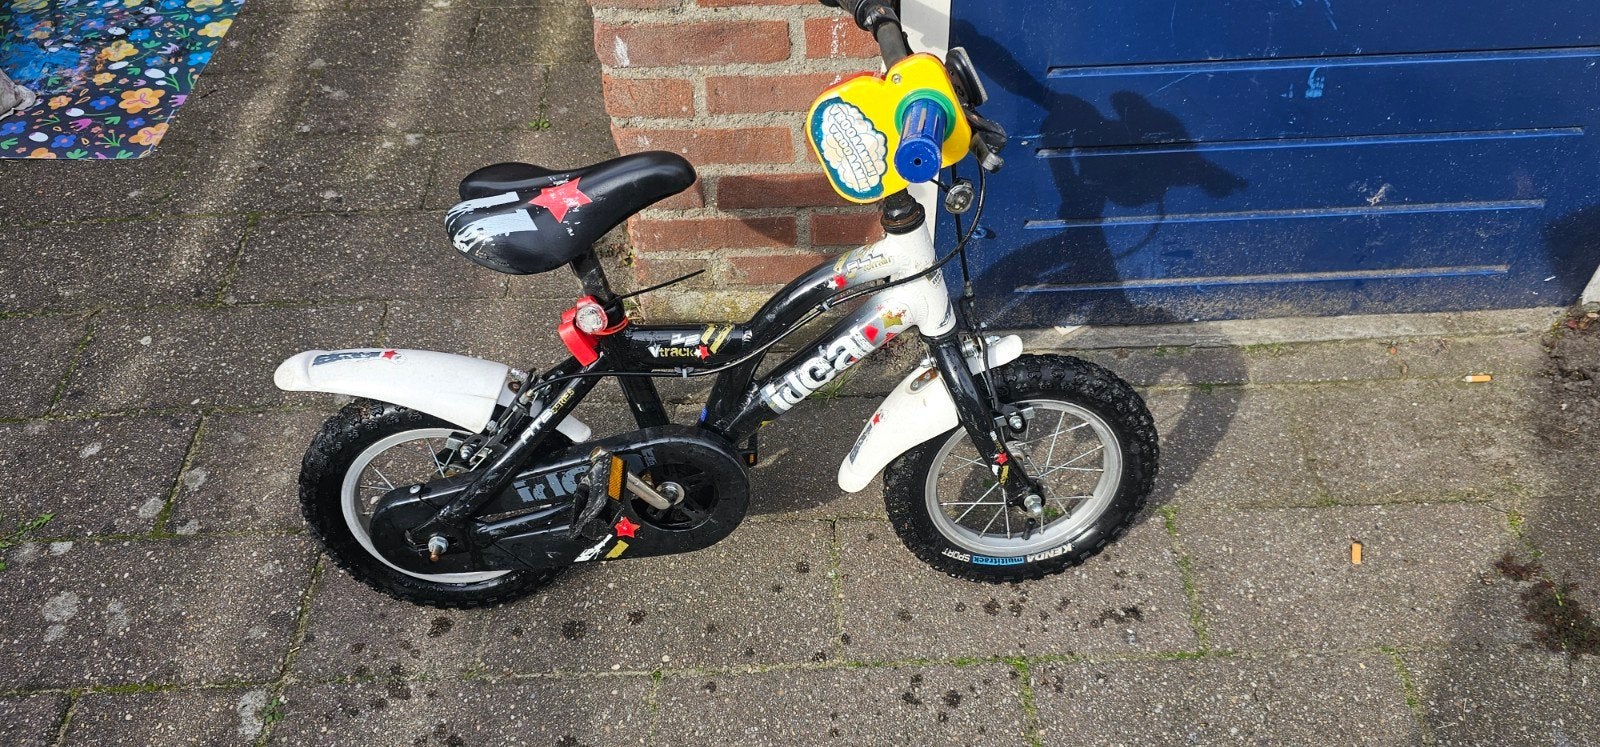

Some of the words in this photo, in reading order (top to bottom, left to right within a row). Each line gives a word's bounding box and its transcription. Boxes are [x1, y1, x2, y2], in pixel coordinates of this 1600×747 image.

[941, 547, 971, 563] SPORT
[973, 556, 1024, 566] multitrack
[1026, 543, 1074, 563] KENDA
